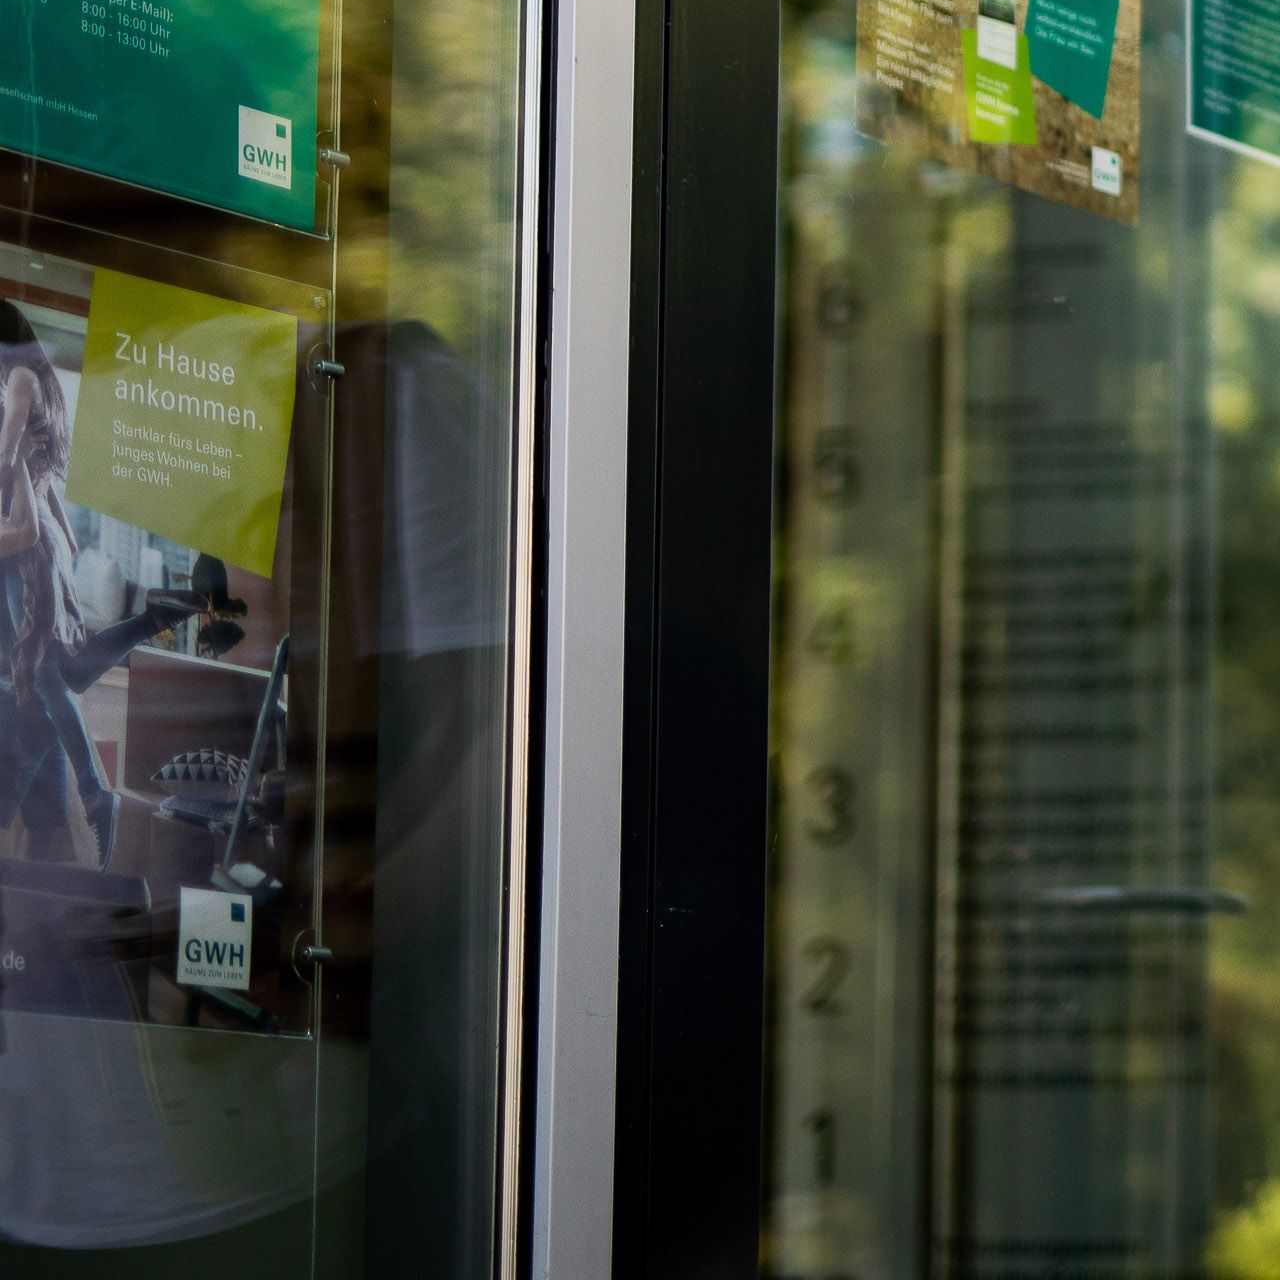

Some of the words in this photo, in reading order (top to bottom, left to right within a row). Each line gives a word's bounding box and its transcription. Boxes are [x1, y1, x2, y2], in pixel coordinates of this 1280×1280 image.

[81, 19, 105, 38] 8:00
[117, 31, 146, 51] 13:00
[149, 40, 171, 58] Uhr
[82, 1, 106, 19] 8:00
[117, 12, 147, 32] 16:00
[150, 22, 171, 40] Uhr
[46, 100, 66, 112] mbH
[68, 104, 98, 121] Hessen
[242, 143, 287, 172] GWH
[115, 332, 147, 365] Zu
[157, 342, 236, 386] Hause
[115, 378, 265, 432] ankommen.
[112, 420, 165, 445] Startklar
[168, 431, 193, 451] fürs
[196, 438, 232, 459] Leben
[112, 442, 154, 465] junges
[157, 452, 209, 476] Wohnen
[212, 461, 231, 480] bei
[112, 463, 134, 478] der
[137, 467, 174, 488] GWH.
[184, 938, 245, 968] GWH
